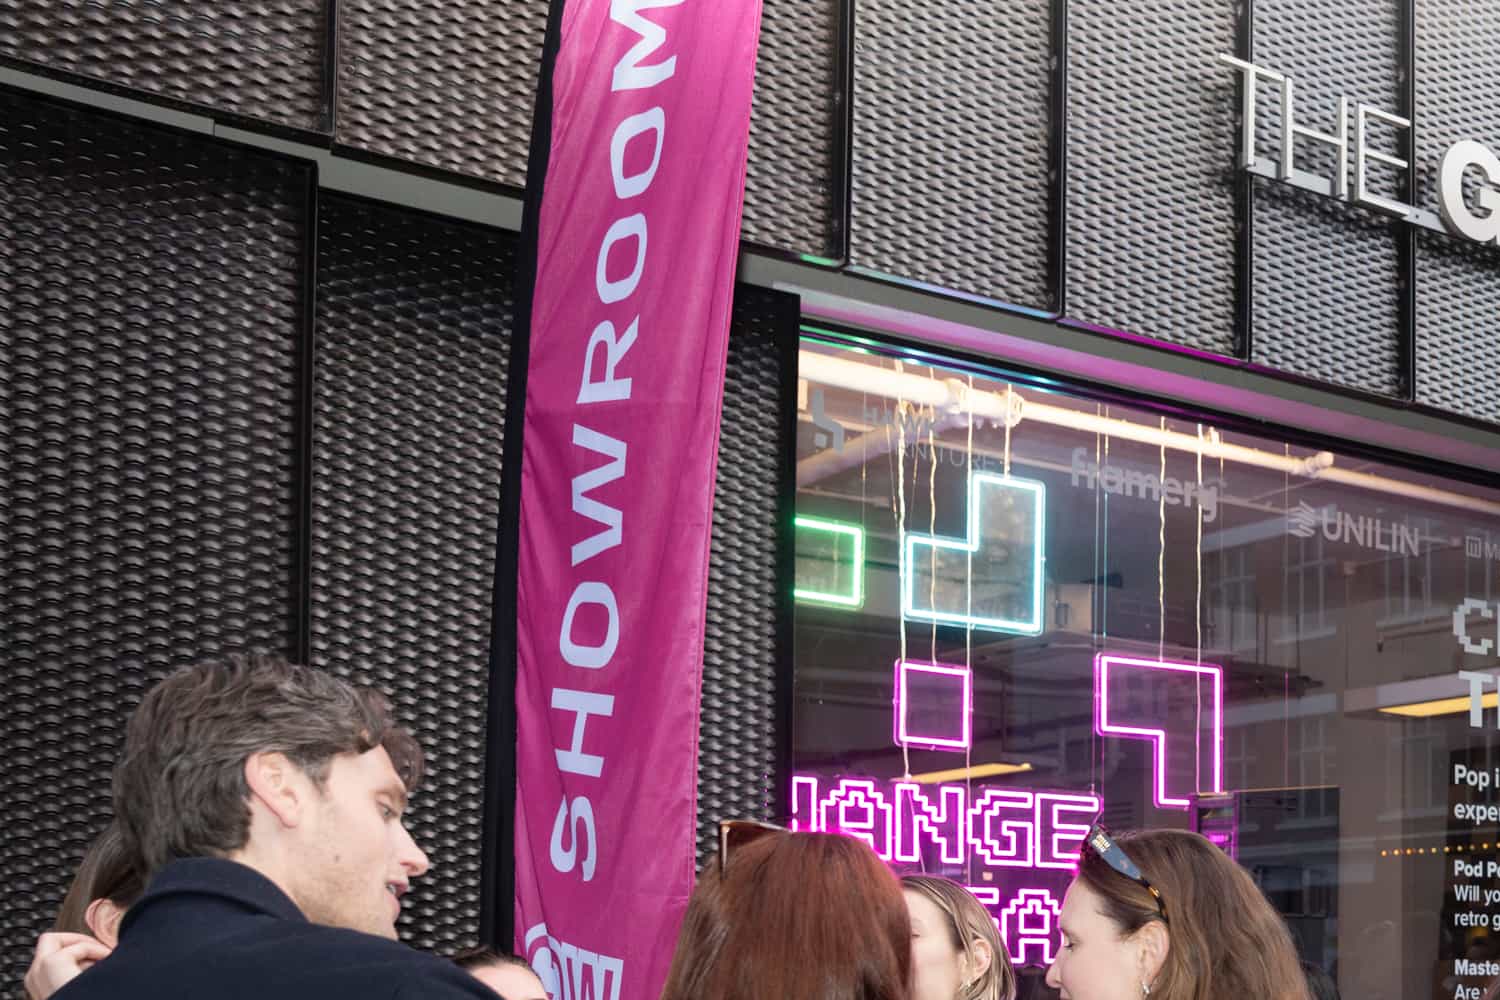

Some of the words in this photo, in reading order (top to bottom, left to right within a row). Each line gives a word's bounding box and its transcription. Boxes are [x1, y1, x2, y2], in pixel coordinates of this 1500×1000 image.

[1220, 53, 1411, 218] THE
[550, 0, 685, 881] SHOWROOM
[1071, 448, 1220, 522] framery
[1322, 507, 1420, 557] UNILIN
[1454, 764, 1489, 791] Pop
[1454, 861, 1483, 877] Pod
[1454, 884, 1479, 901] Will
[1454, 912, 1489, 926] retro
[1454, 984, 1480, 1000] Are
